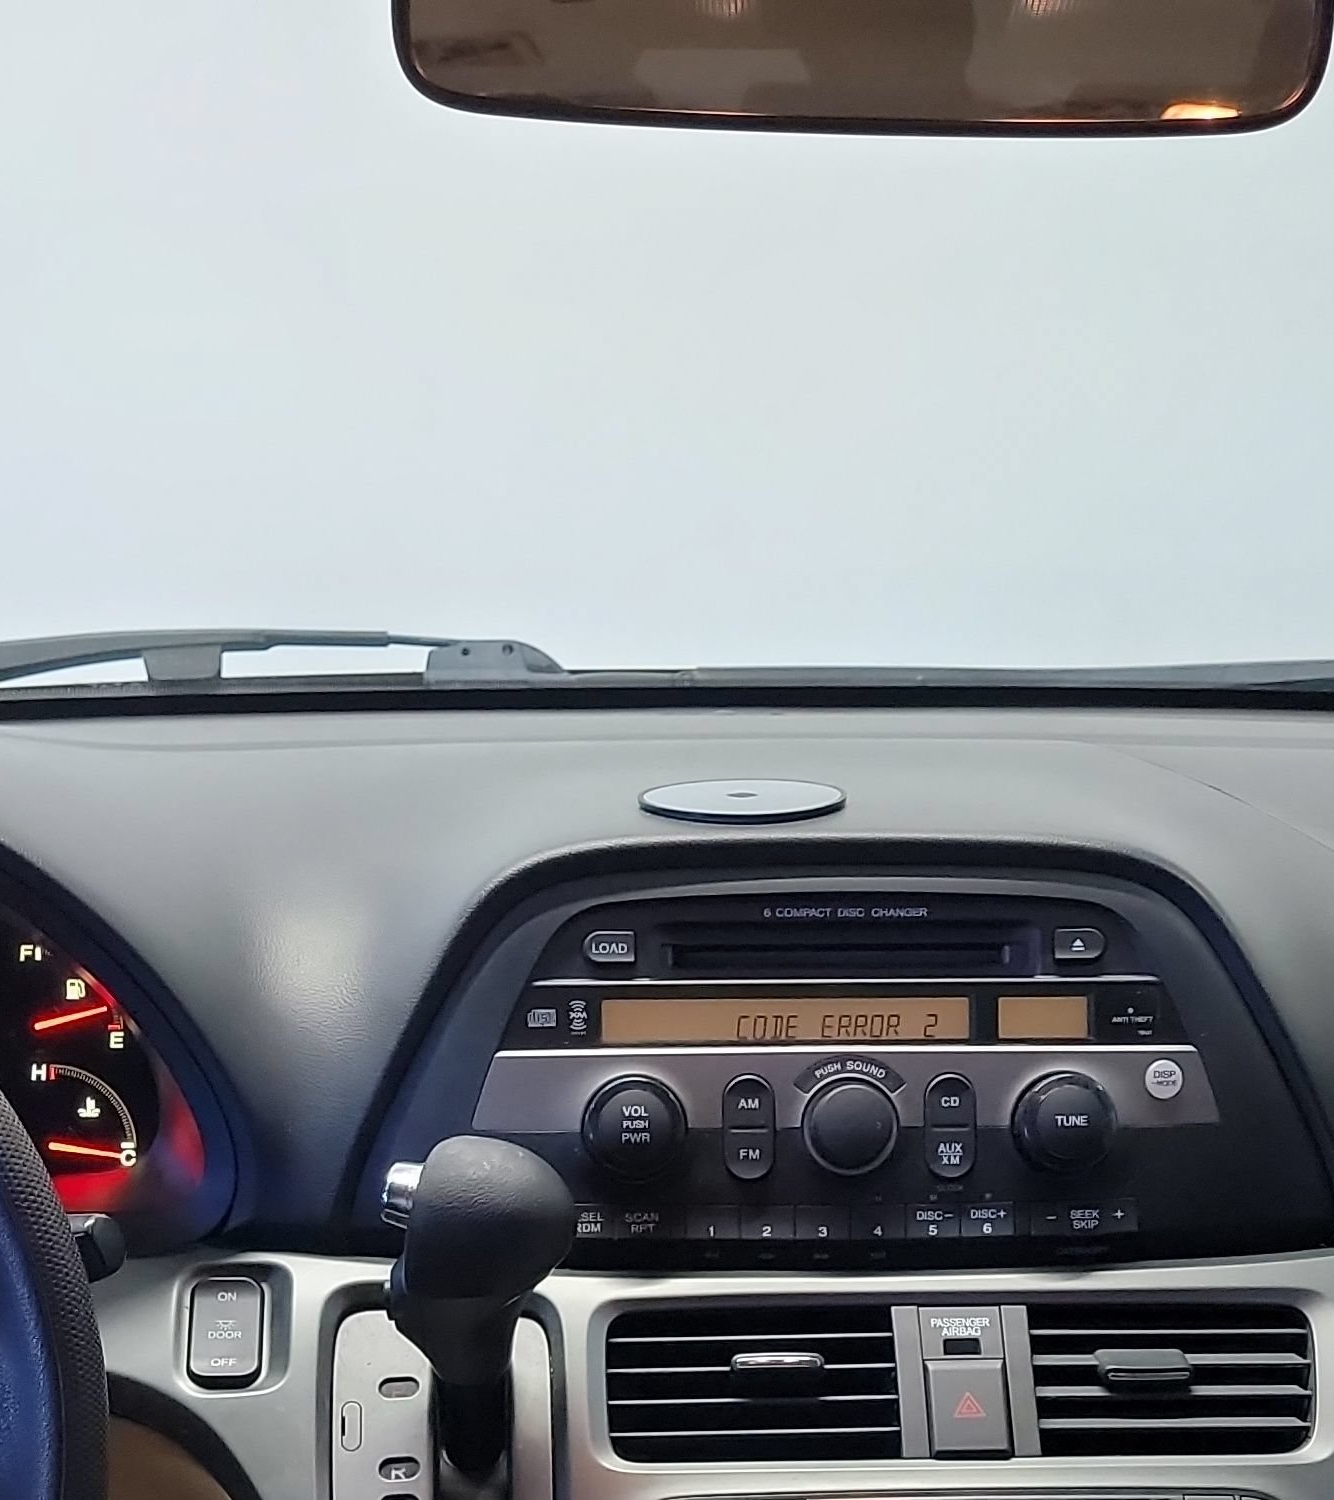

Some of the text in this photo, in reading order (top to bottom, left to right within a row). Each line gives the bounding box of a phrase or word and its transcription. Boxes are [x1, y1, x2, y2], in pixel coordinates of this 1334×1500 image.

[763, 908, 928, 917] 6 COMPACT DISC CHANGER
[592, 943, 628, 954] LOAD
[736, 1014, 938, 1039] CODE ERROR 2
[109, 1032, 125, 1049] E
[31, 1064, 47, 1081] H
[814, 1060, 886, 1079] PUSH SOUND
[1153, 1070, 1177, 1079] DISP
[738, 1098, 759, 1110] AM
[941, 1096, 959, 1107] CD
[622, 1106, 648, 1117] VOL
[622, 1120, 649, 1129] PUSH
[1055, 1115, 1088, 1127] TUNE
[621, 1133, 650, 1144] PWR
[938, 1143, 963, 1153] AUX
[120, 1149, 137, 1167] C
[740, 1149, 760, 1160] FM
[942, 1155, 960, 1165] XM
[625, 1212, 660, 1223] SCAN
[1070, 1209, 1099, 1219] SEEK
[630, 1223, 656, 1233] RPT
[928, 1224, 938, 1236] 5
[983, 1222, 993, 1234] 6
[1072, 1220, 1099, 1230] SKIP
[708, 1226, 715, 1237] 1
[762, 1226, 772, 1237] 2
[818, 1226, 828, 1237] 3
[873, 1226, 883, 1237] 4
[217, 1292, 237, 1302] ON
[930, 1317, 990, 1327] PASSENGER
[207, 1330, 242, 1340] DOOR
[941, 1326, 982, 1336] AIRBAG
[210, 1357, 237, 1368] OFF
